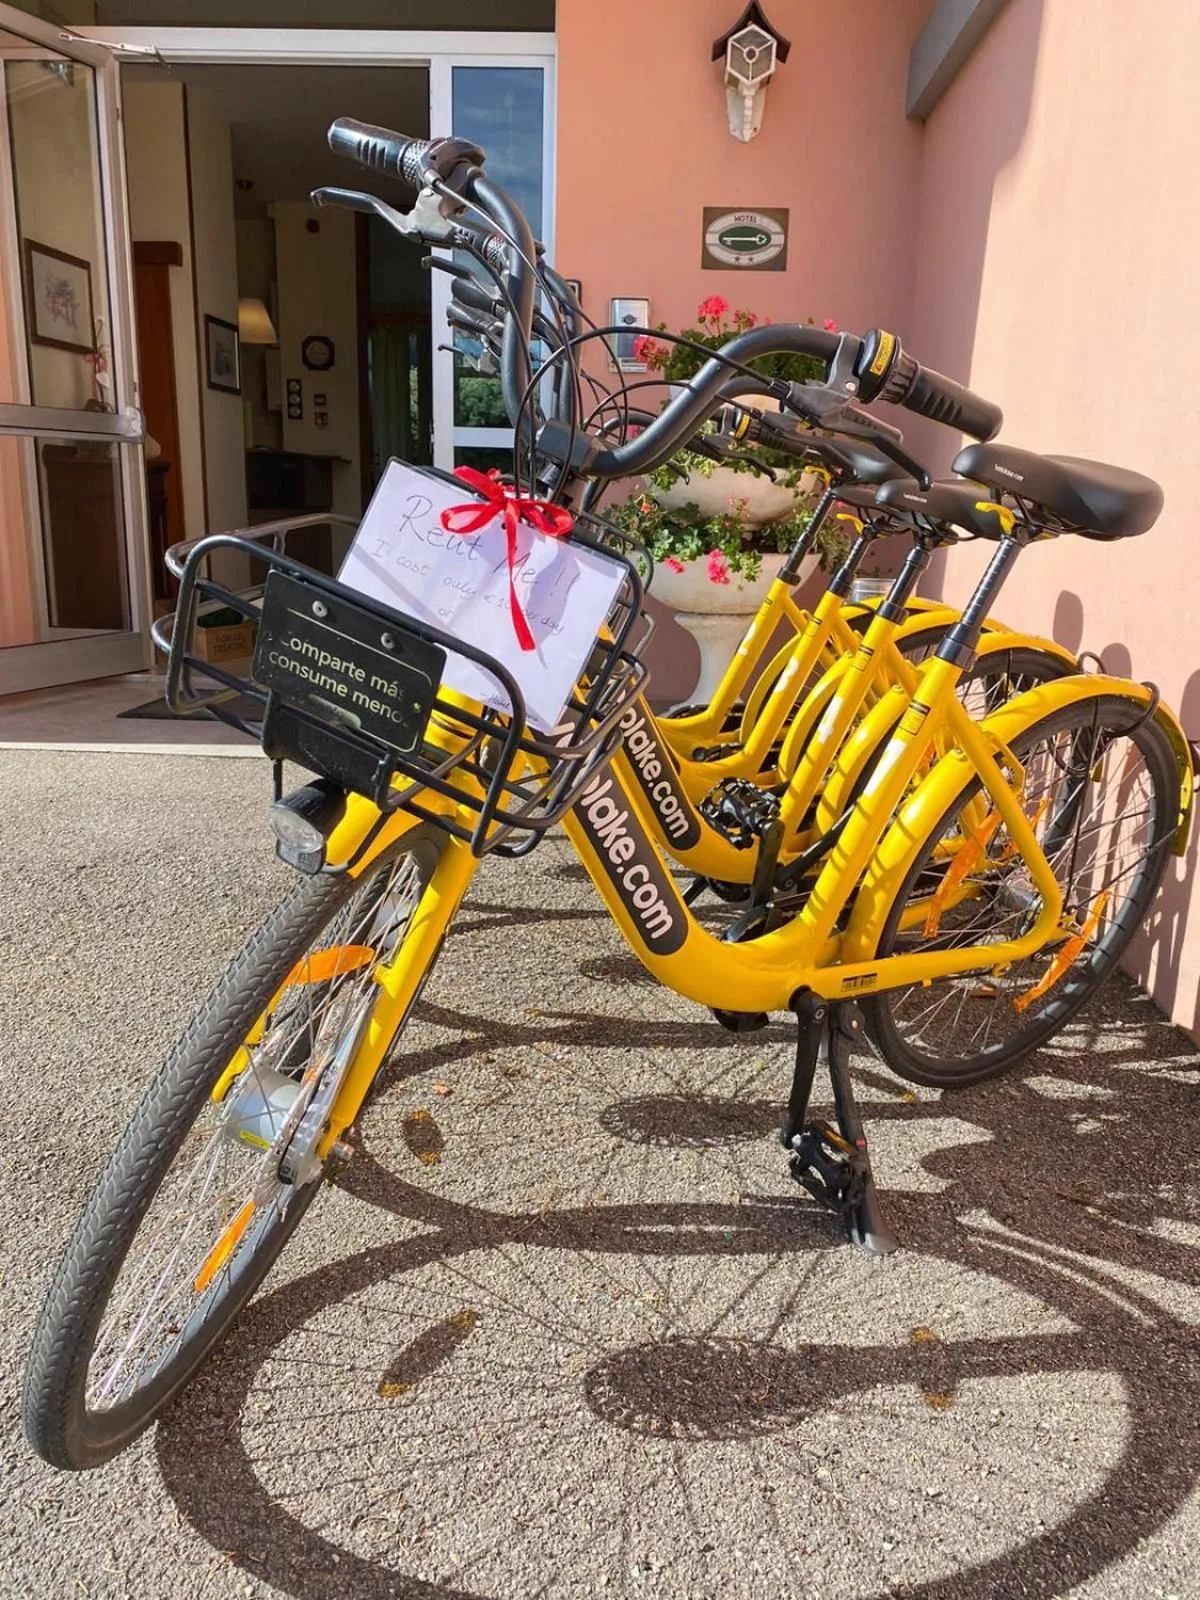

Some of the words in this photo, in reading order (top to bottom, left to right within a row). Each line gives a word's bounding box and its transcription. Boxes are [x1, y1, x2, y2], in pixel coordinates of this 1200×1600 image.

[735, 215, 757, 223] HOTEL
[399, 494, 483, 561] Rent
[371, 538, 390, 558] I
[396, 556, 432, 576] cost
[443, 577, 477, 600] only
[540, 616, 564, 636] day
[269, 651, 348, 698] consume
[352, 690, 408, 727] meno
